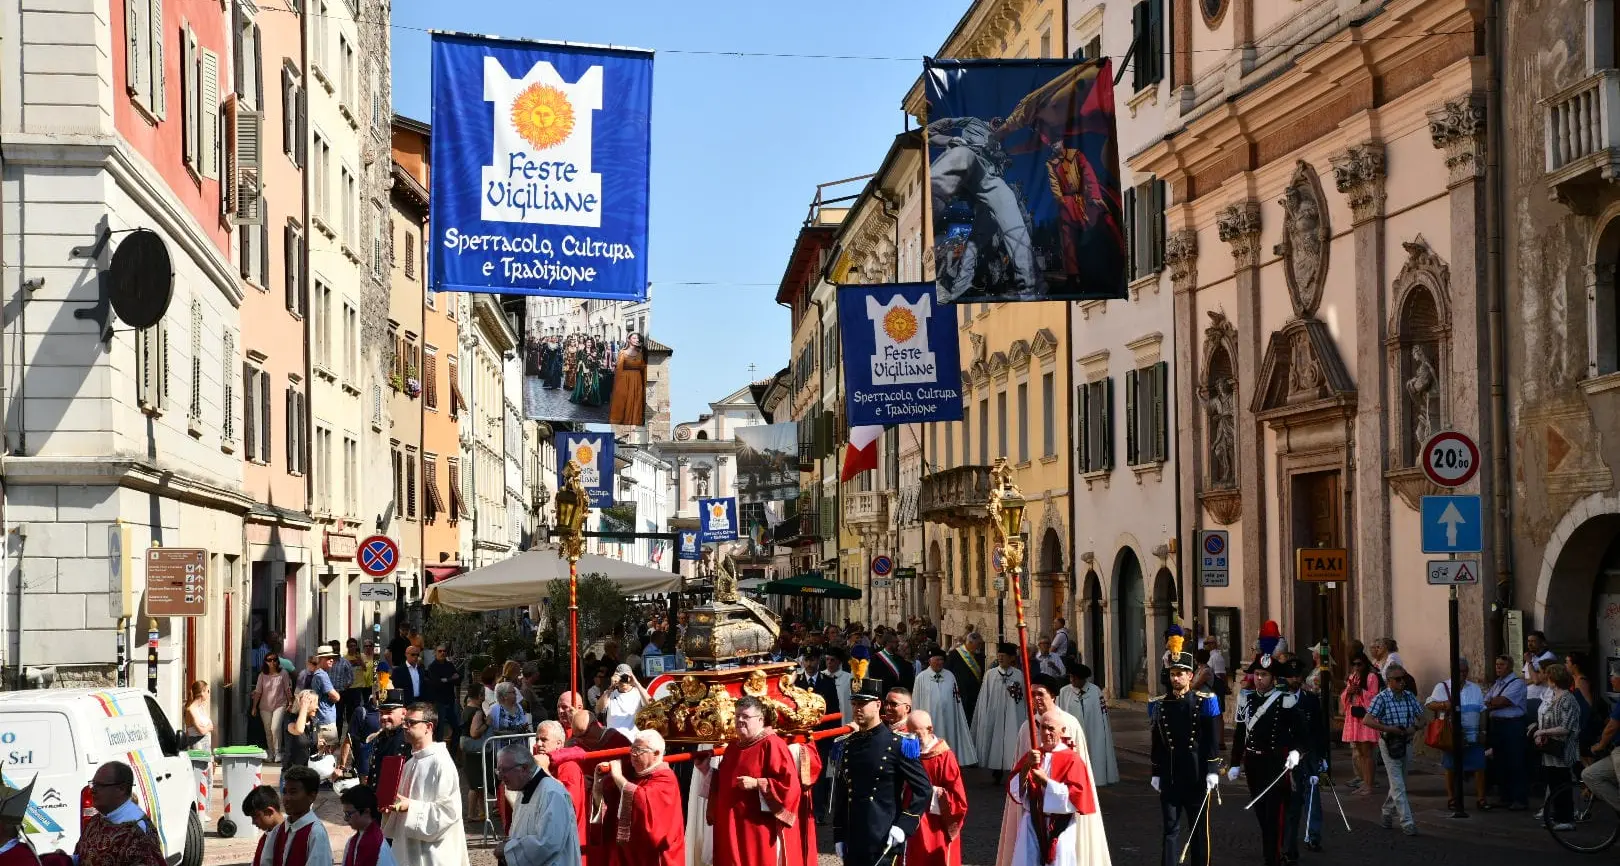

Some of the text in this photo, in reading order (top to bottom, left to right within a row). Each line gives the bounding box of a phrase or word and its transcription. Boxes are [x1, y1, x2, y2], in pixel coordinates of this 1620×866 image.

[508, 152, 578, 182] Feste
[487, 181, 598, 220] Vigiliane
[444, 228, 635, 264] Spettacolo, Cultura
[483, 257, 597, 286] e Tradizione
[884, 345, 922, 360] Feste
[874, 362, 934, 382] Vigiliane
[854, 388, 957, 406] Spettacolo, Cultura
[875, 403, 937, 418] e Tradizione
[1304, 557, 1343, 571] TAXI
[8, 751, 33, 765] Srl
